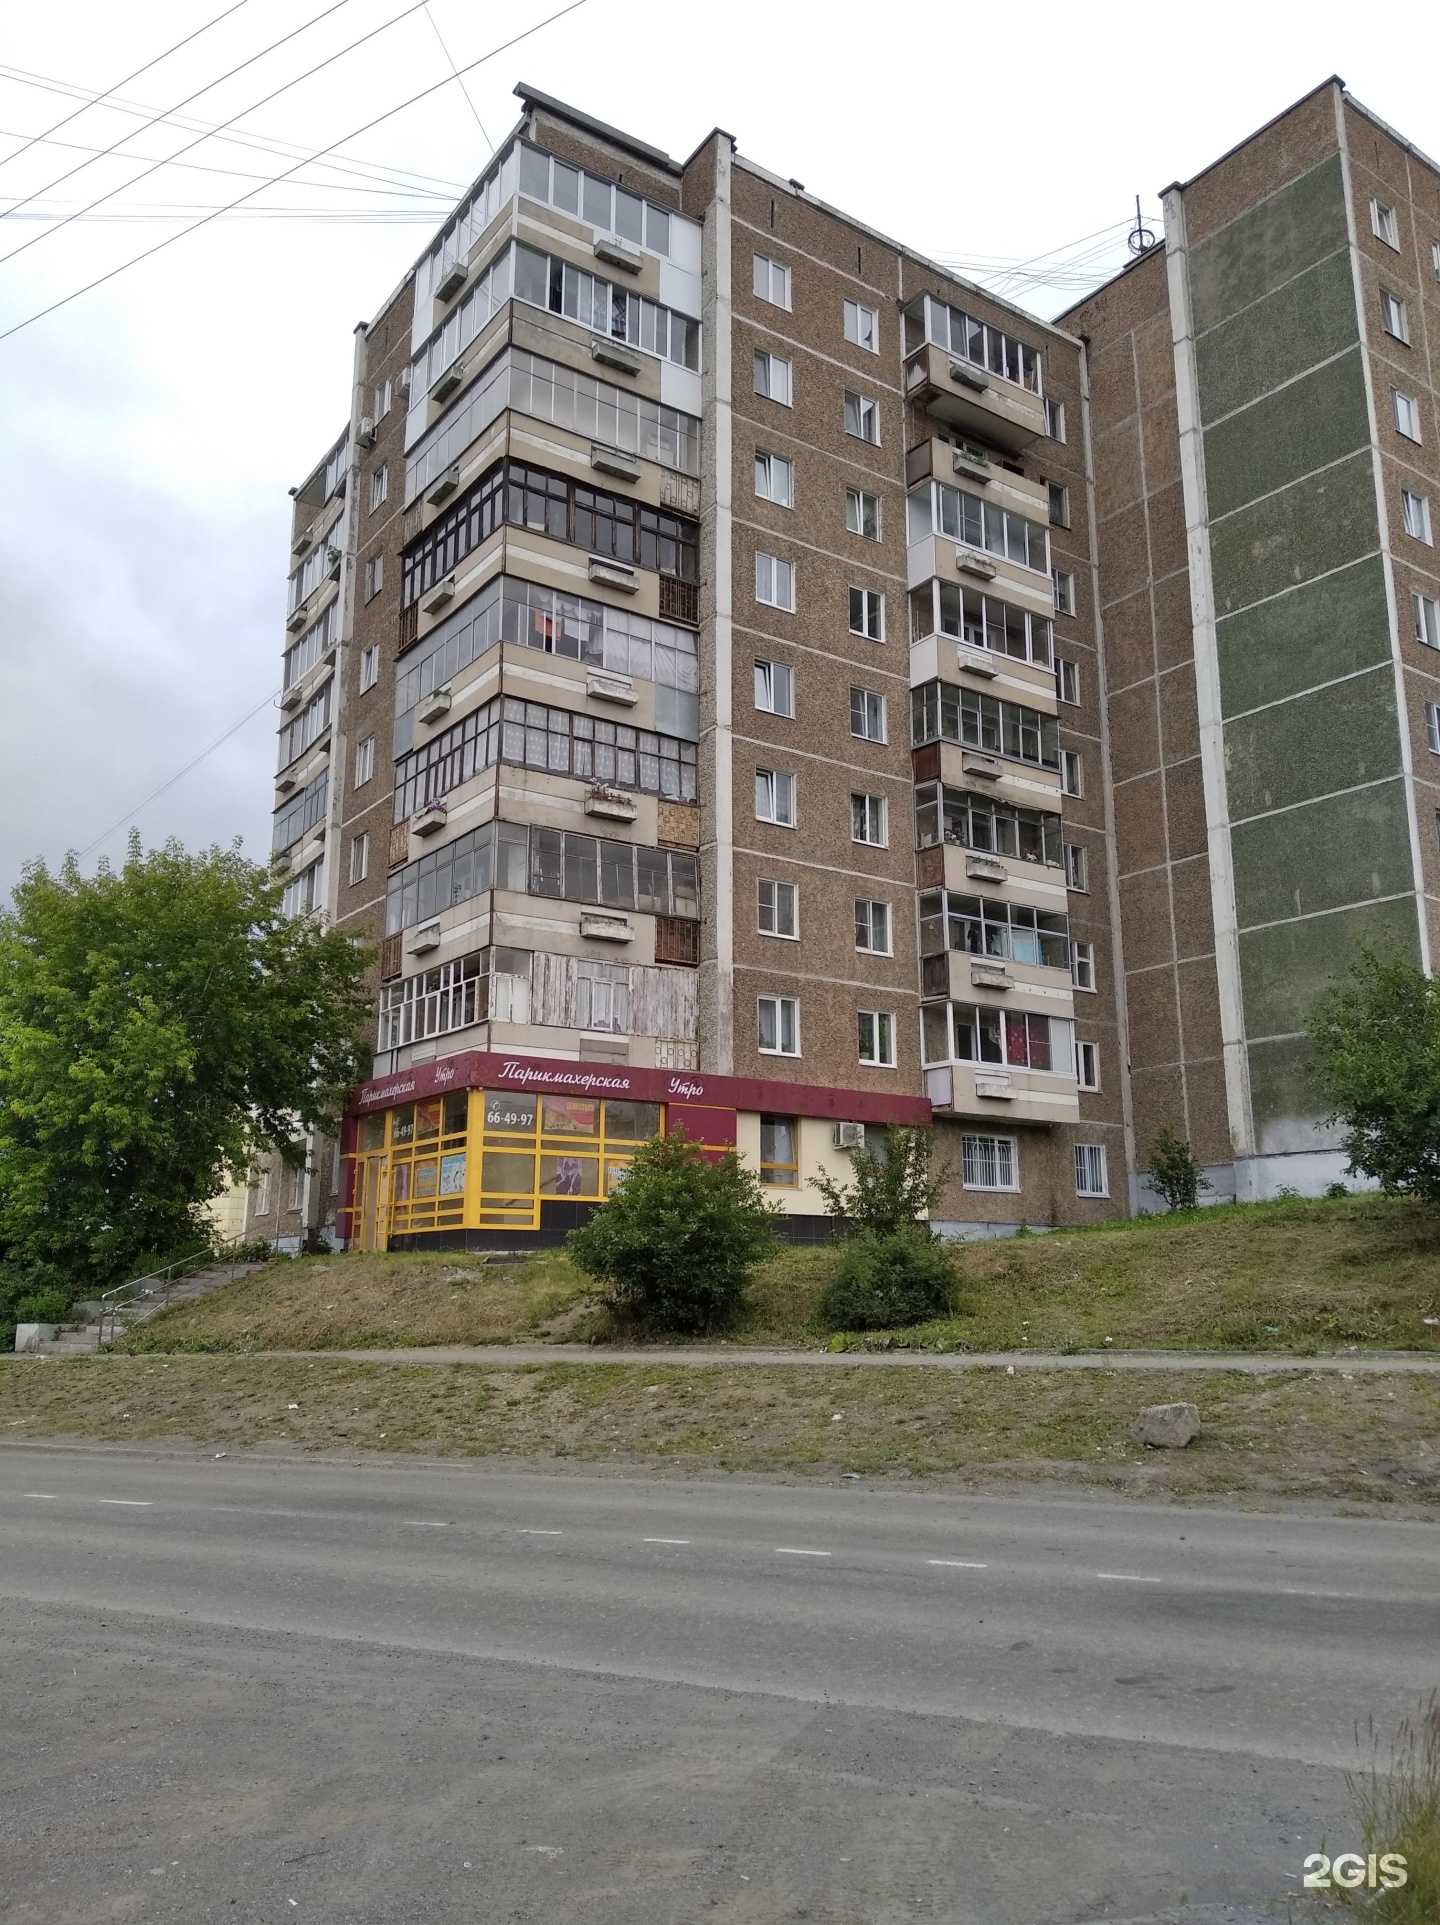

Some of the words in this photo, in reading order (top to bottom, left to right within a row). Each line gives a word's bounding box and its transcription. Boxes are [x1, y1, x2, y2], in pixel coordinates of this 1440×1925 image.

[358, 1081, 415, 1106] Парикмахерская
[435, 1066, 455, 1087] Утро
[498, 1061, 631, 1090] Парикмахерская
[668, 1077, 704, 1096] Утро
[487, 1111, 534, 1126] 66-49-97
